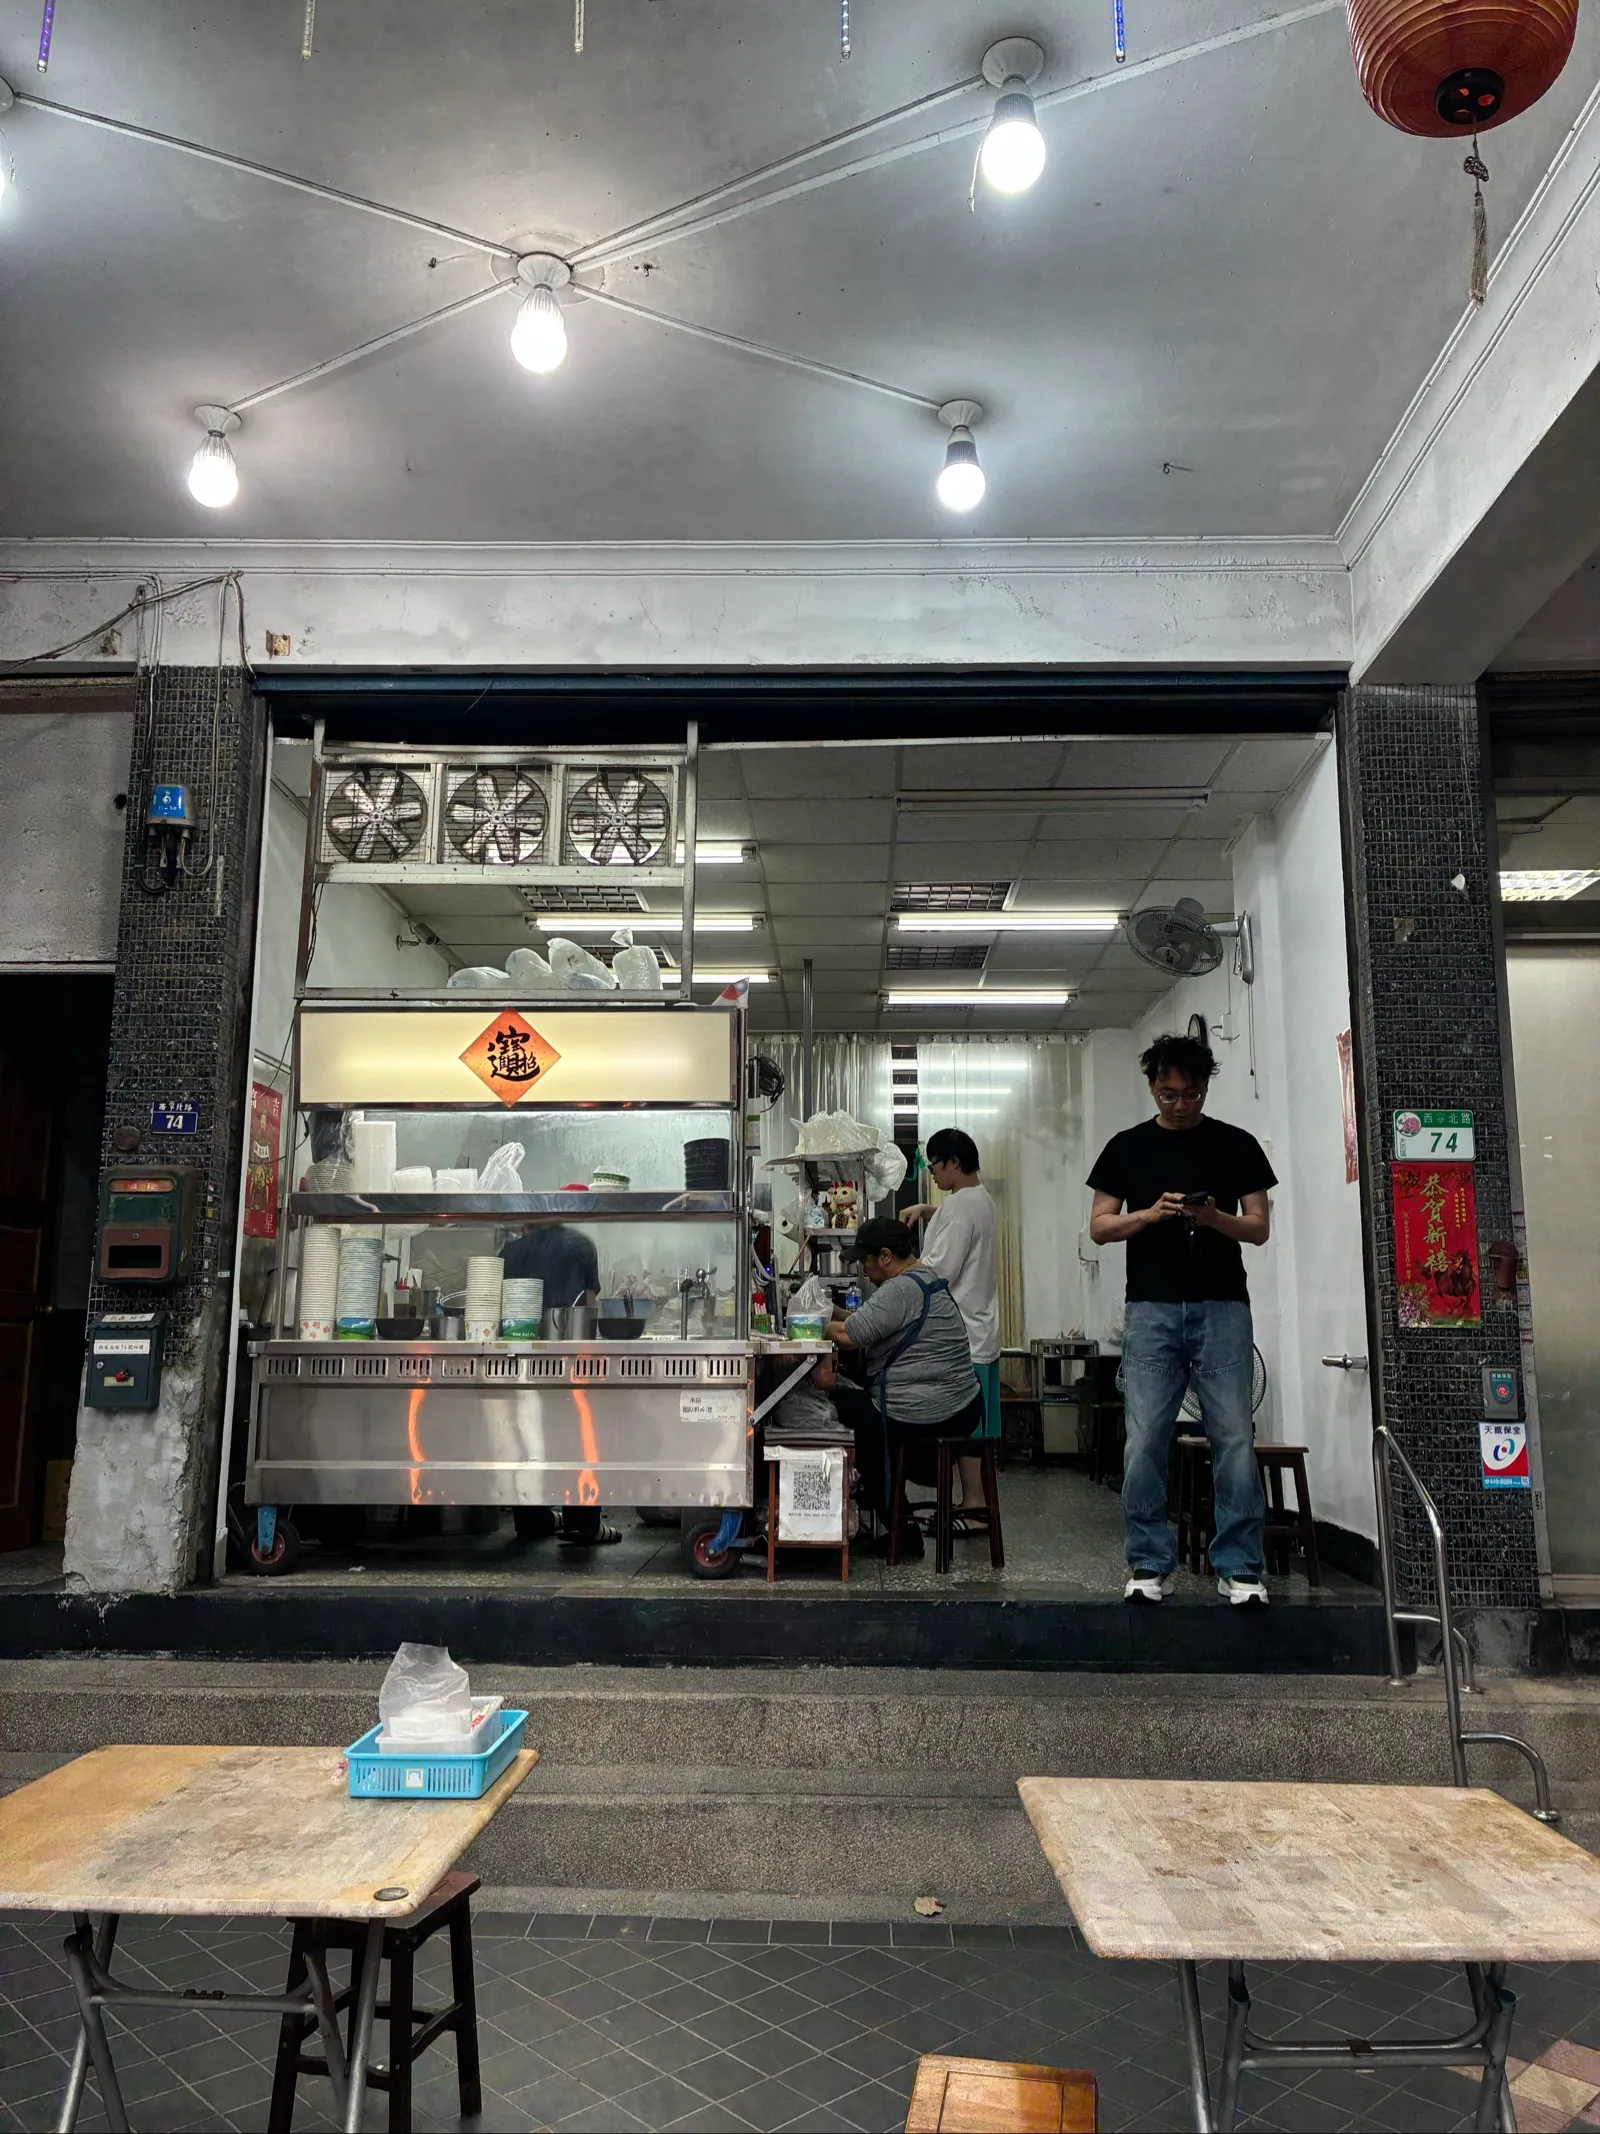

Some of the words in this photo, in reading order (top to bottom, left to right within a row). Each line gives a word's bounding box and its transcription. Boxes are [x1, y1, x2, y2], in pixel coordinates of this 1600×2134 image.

[165, 1115, 184, 1130] 74
[1423, 1112, 1471, 1125] 西寧北路
[1430, 1132, 1458, 1153] 74
[1420, 1173, 1452, 1273] 恭賀新禧
[1484, 1425, 1521, 1435] 天威保全
